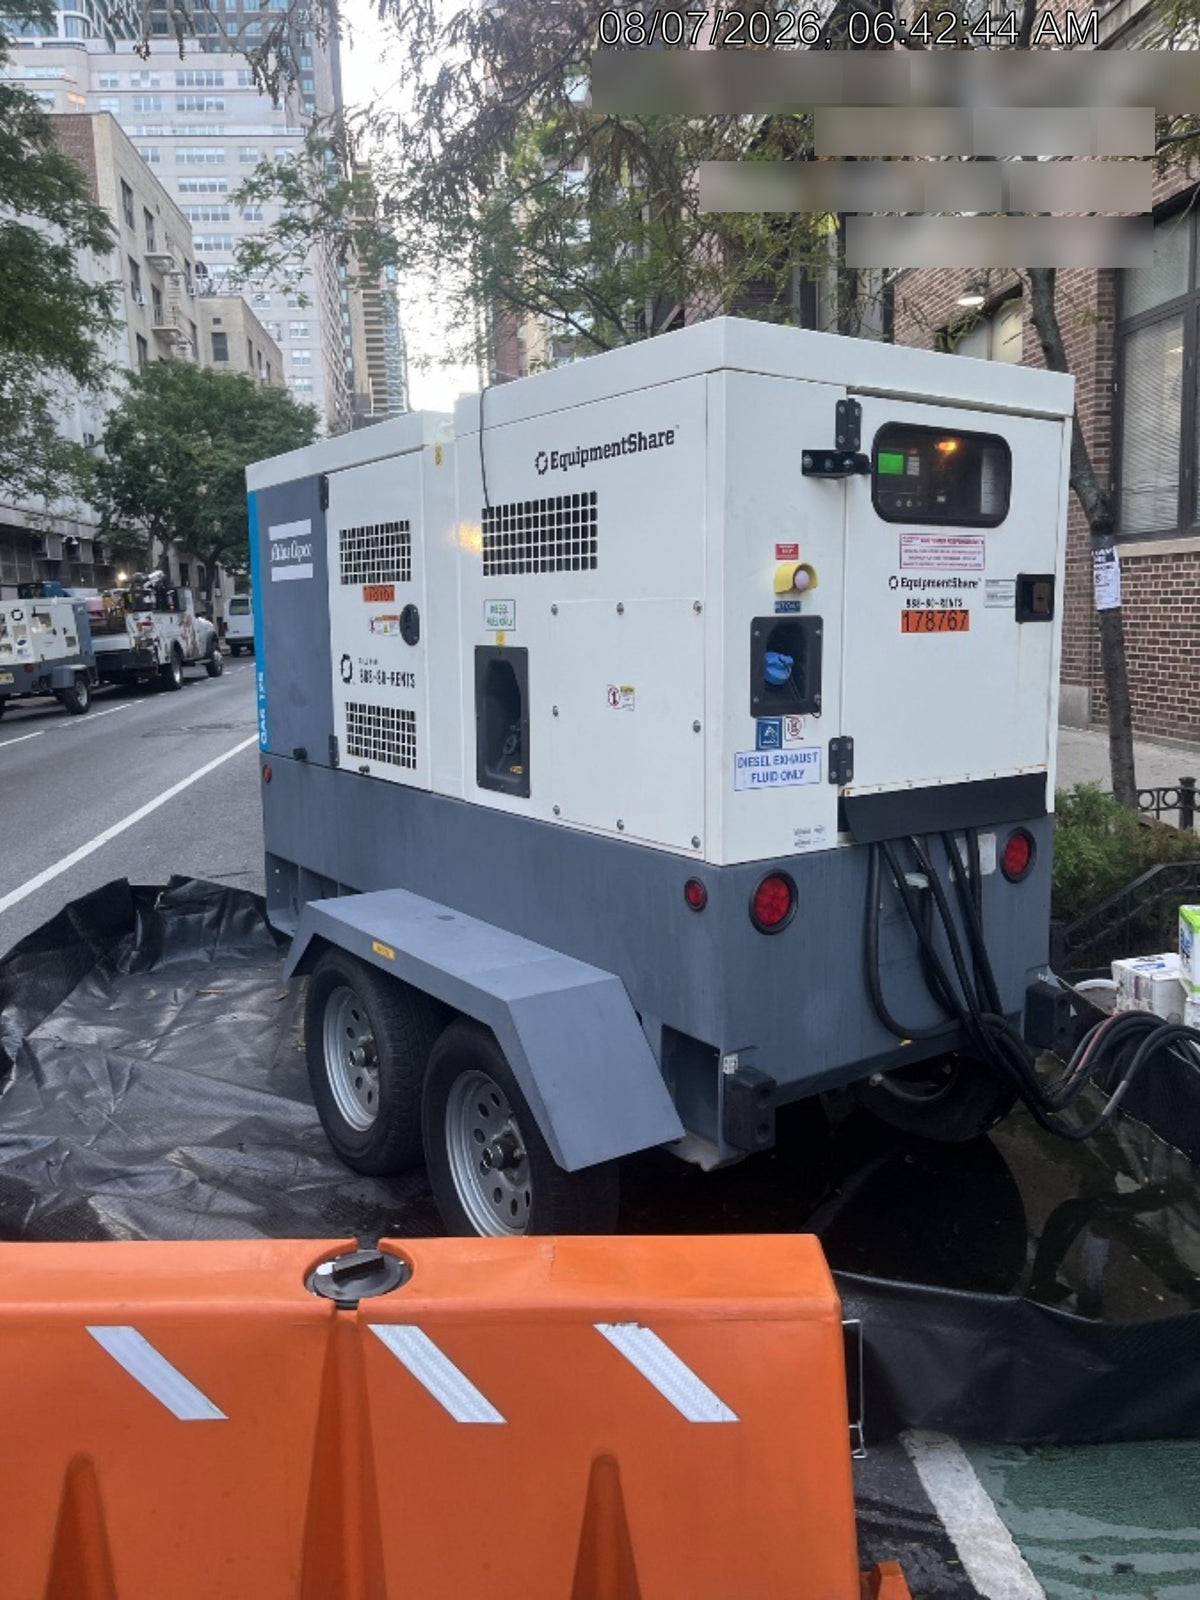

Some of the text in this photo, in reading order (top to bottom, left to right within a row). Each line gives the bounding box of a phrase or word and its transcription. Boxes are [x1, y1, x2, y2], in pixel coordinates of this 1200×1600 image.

[550, 429, 675, 472] EquipmentShare
[901, 576, 979, 591] EquipmentShare
[902, 610, 969, 632] 178767
[737, 752, 819, 769] DIESEL EXHAUST
[751, 769, 805, 783] FLUID ONLY
